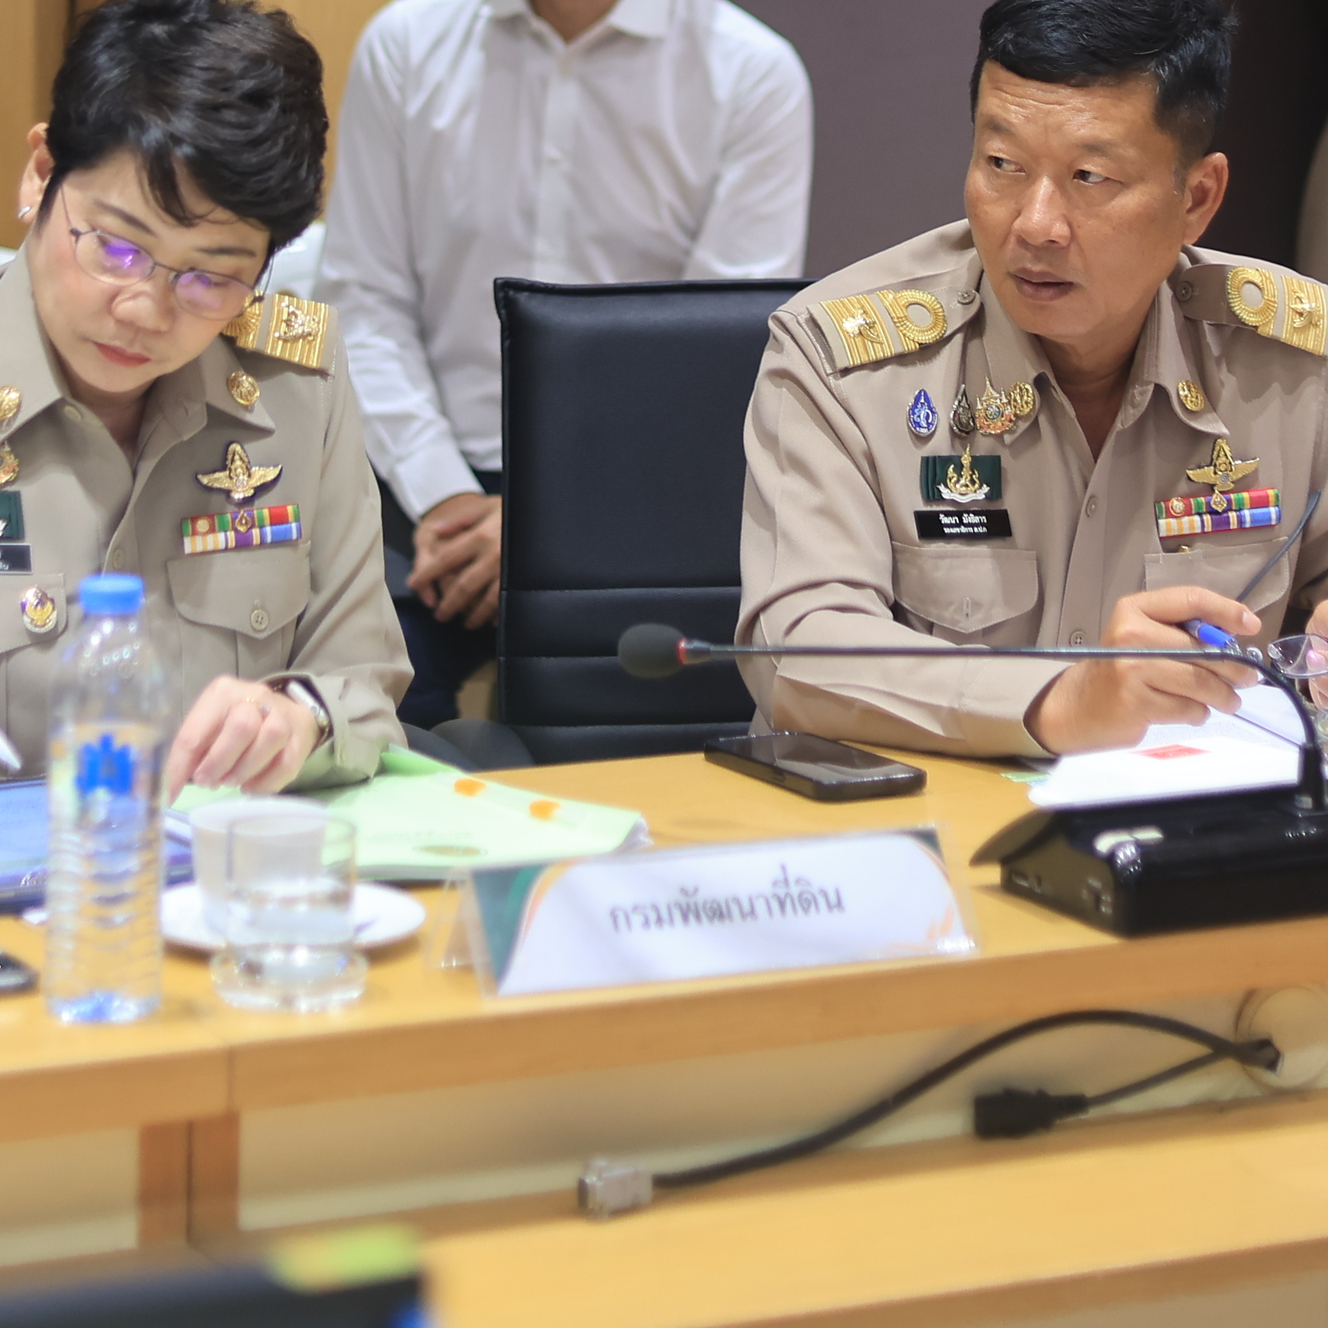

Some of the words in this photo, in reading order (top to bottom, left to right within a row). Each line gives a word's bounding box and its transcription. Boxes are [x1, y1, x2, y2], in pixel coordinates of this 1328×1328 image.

[609, 863, 846, 935] กรมพัฒนาที่ดิน
